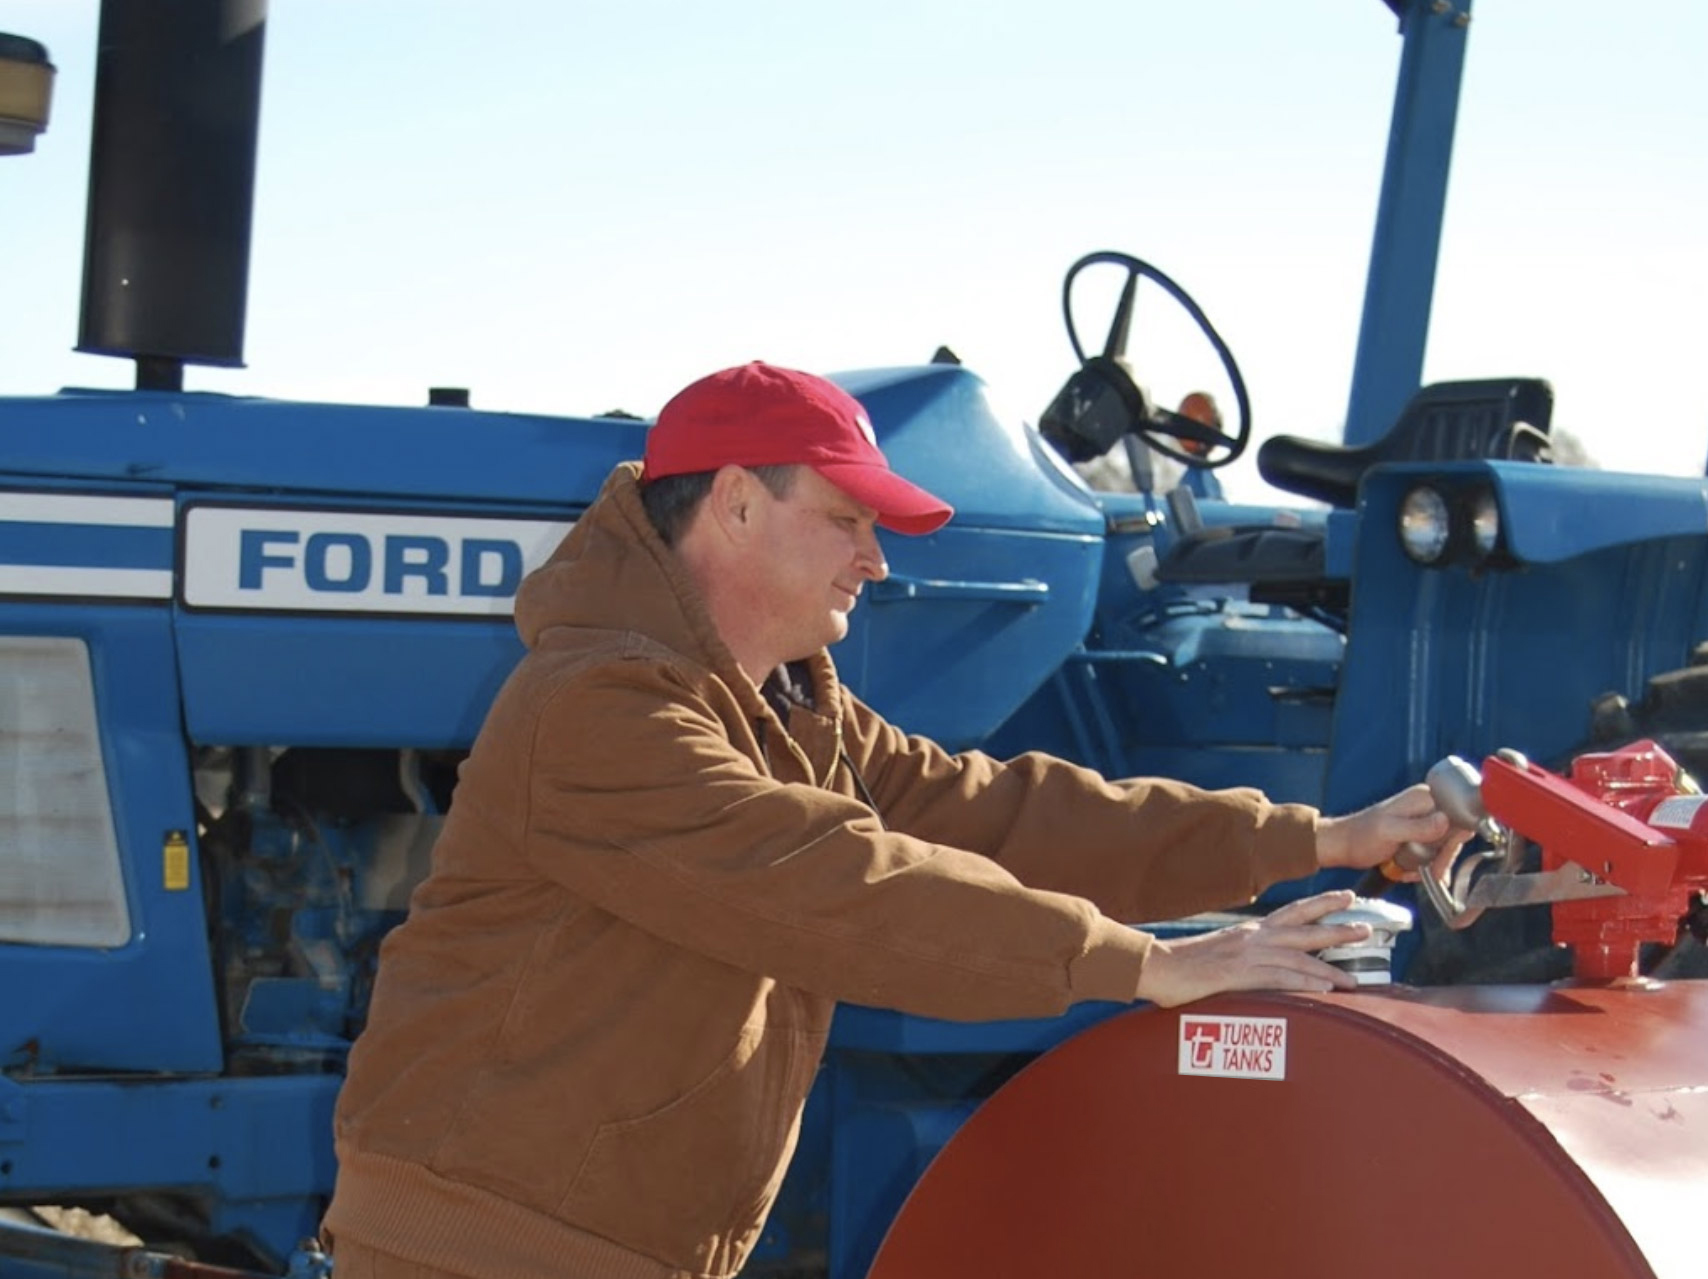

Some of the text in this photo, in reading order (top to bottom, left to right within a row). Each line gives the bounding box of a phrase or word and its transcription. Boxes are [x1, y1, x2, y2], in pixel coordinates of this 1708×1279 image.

[238, 529, 524, 599] FORD
[1223, 1023, 1283, 1048] TURNER
[1222, 1048, 1273, 1072] TANKS
